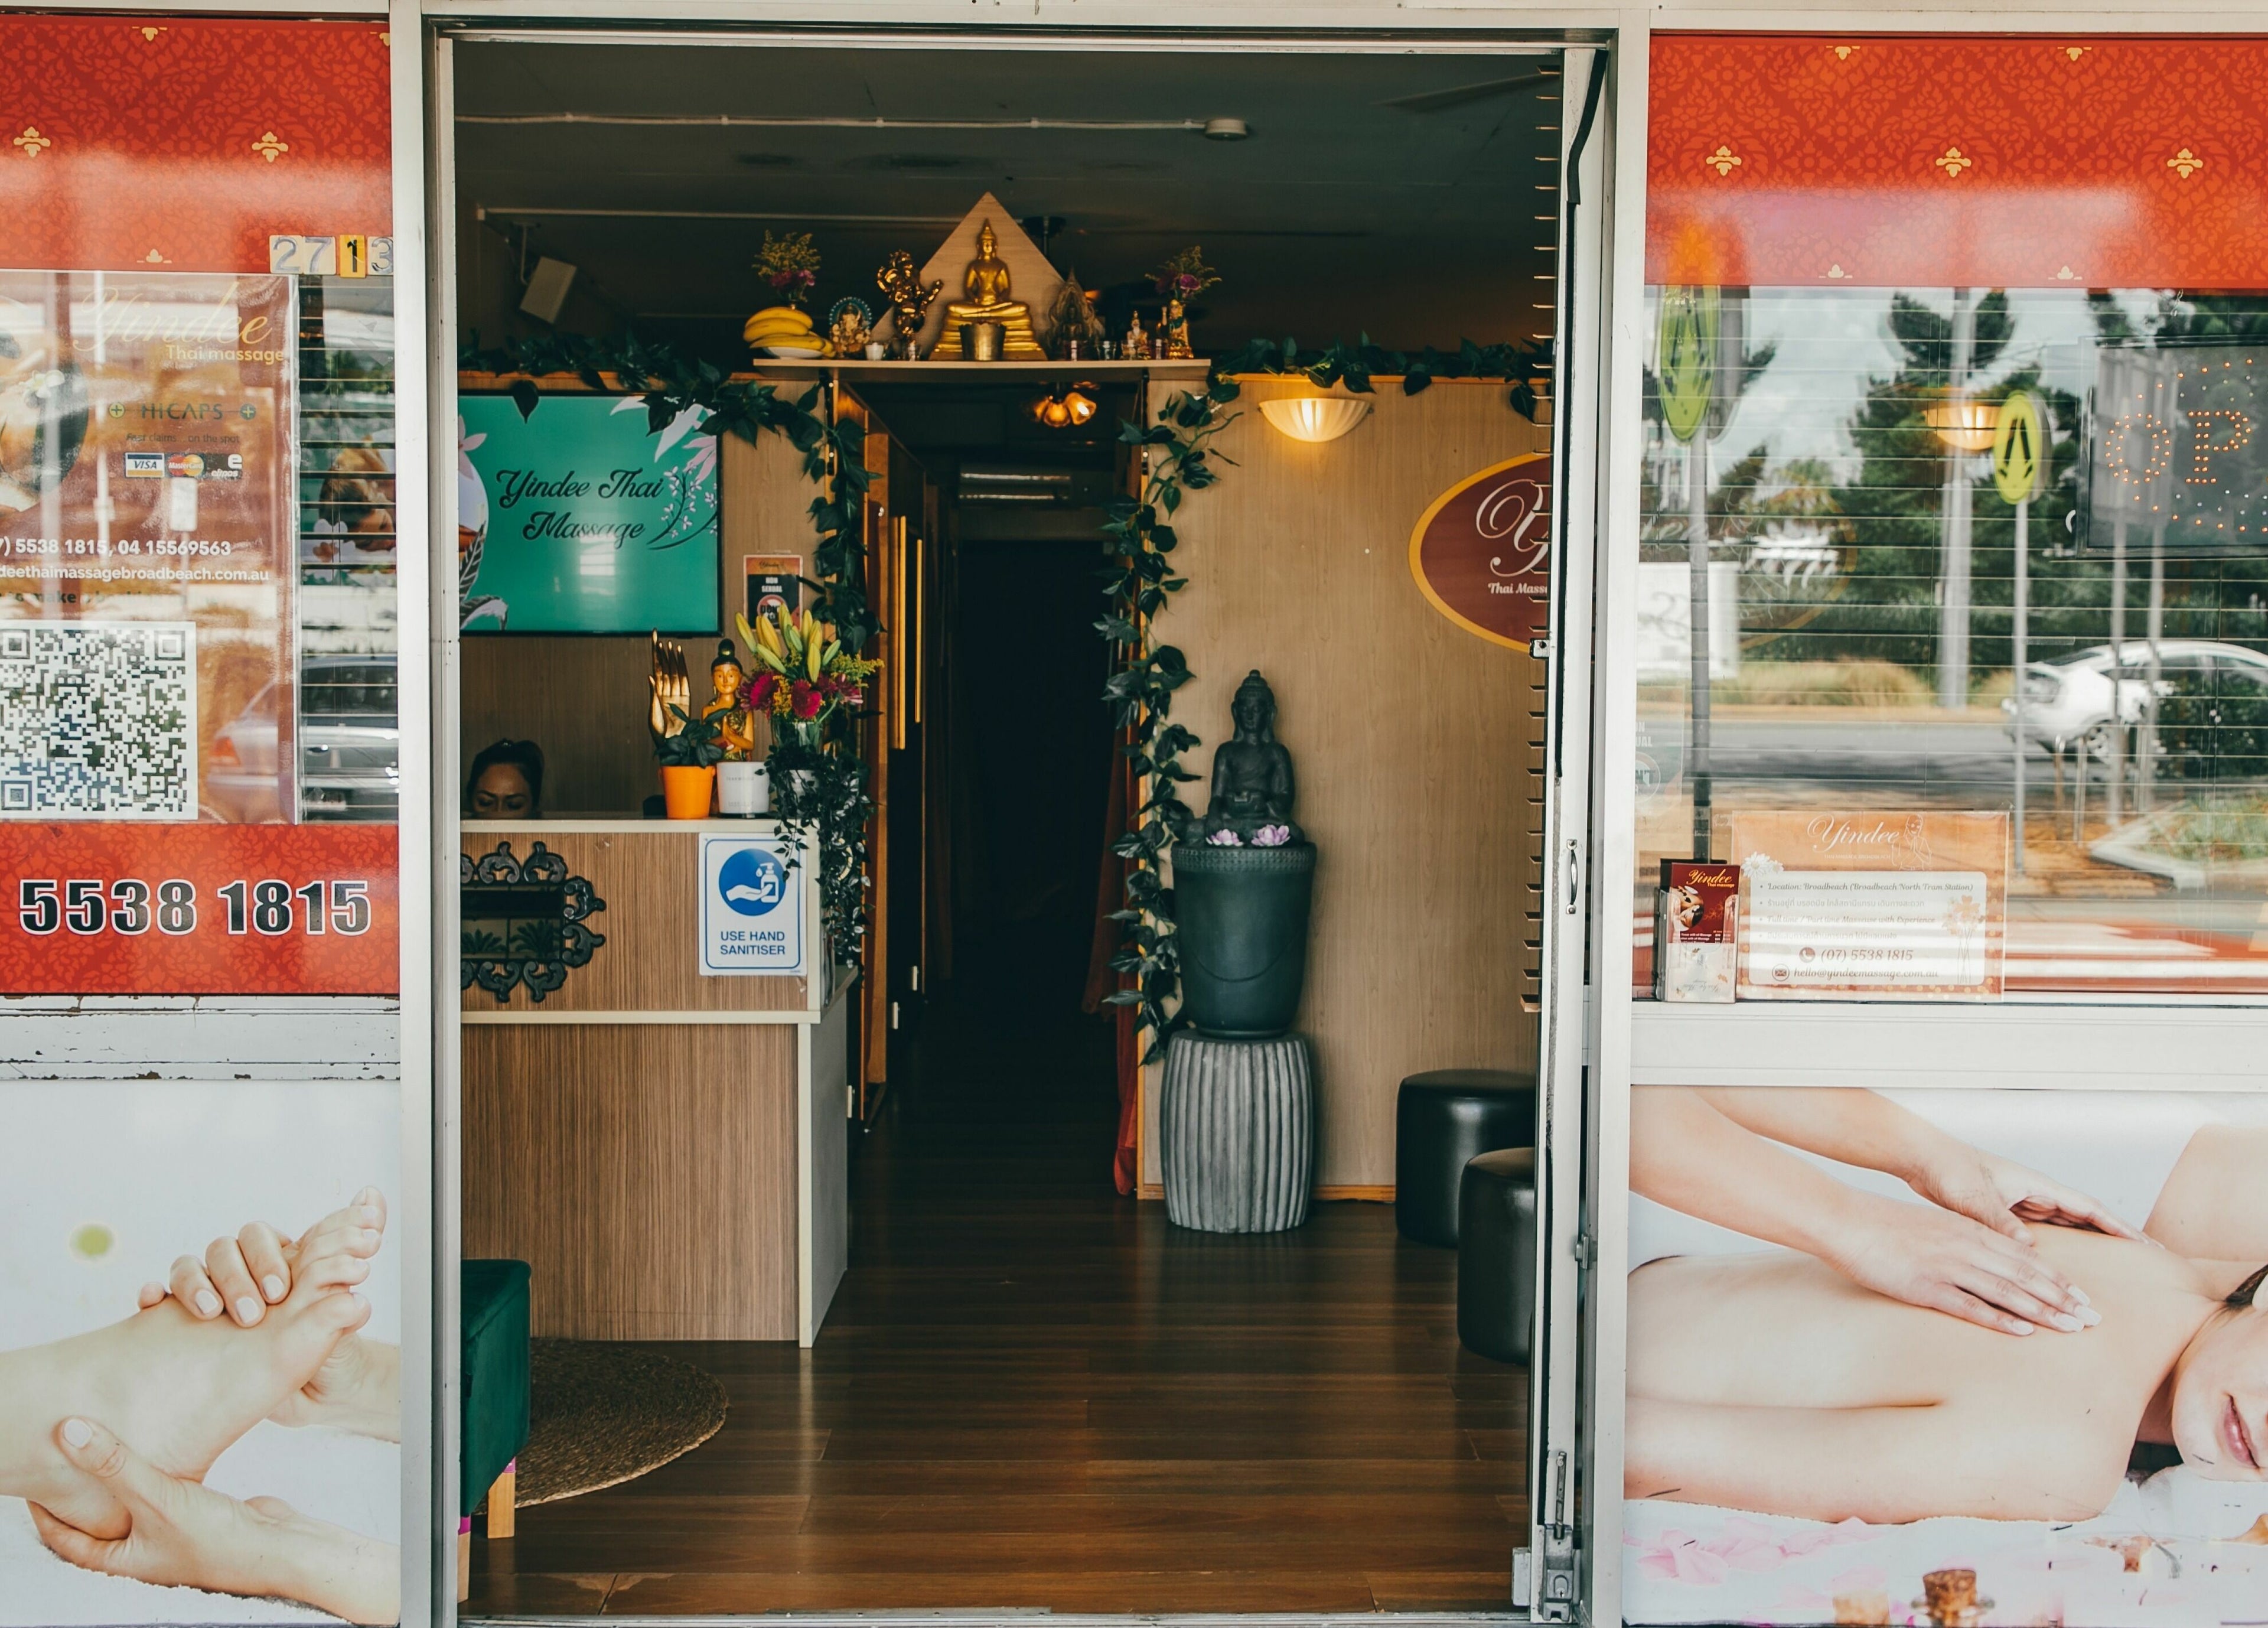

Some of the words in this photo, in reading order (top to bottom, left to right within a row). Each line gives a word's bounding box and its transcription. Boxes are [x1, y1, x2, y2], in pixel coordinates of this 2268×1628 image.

[273, 237, 393, 273] 2713
[73, 282, 272, 352] Yindee
[165, 344, 204, 360] Thai
[206, 348, 285, 365] massage
[203, 434, 220, 442] the
[220, 435, 240, 444] spot
[2104, 411, 2253, 486] OP
[135, 461, 157, 469] VISA
[496, 469, 591, 509] Yindee
[598, 467, 664, 499] Thai
[522, 510, 646, 550] Massage
[15, 538, 58, 554] 5538
[65, 539, 113, 557] 1815,
[118, 539, 141, 555] 04
[145, 540, 232, 556] 15569563
[0, 565, 269, 582] deethaimassagebroadbeach.com.au
[1487, 582, 1514, 594] Thai
[1516, 582, 1547, 594] Mass
[1807, 813, 1900, 853] Yindee
[1686, 868, 1733, 885] Yindee
[1767, 883, 1801, 891] Location:
[1803, 883, 1848, 891] Broadbeach
[1850, 883, 1897, 892] (Broadbeach
[1899, 883, 1921, 891] North
[1944, 883, 1973, 891] Station)
[19, 878, 197, 937] 5538
[217, 879, 372, 937] 1815
[1896, 916, 1935, 925] Experience
[721, 931, 745, 941] USE
[750, 931, 785, 941] HAND
[720, 945, 786, 955] SANITISER
[1821, 949, 1846, 963] (07)
[1851, 949, 1883, 960] 5538
[1887, 949, 1914, 960] 1815
[1794, 968, 1940, 981] hello@yindeemassage.com.au
